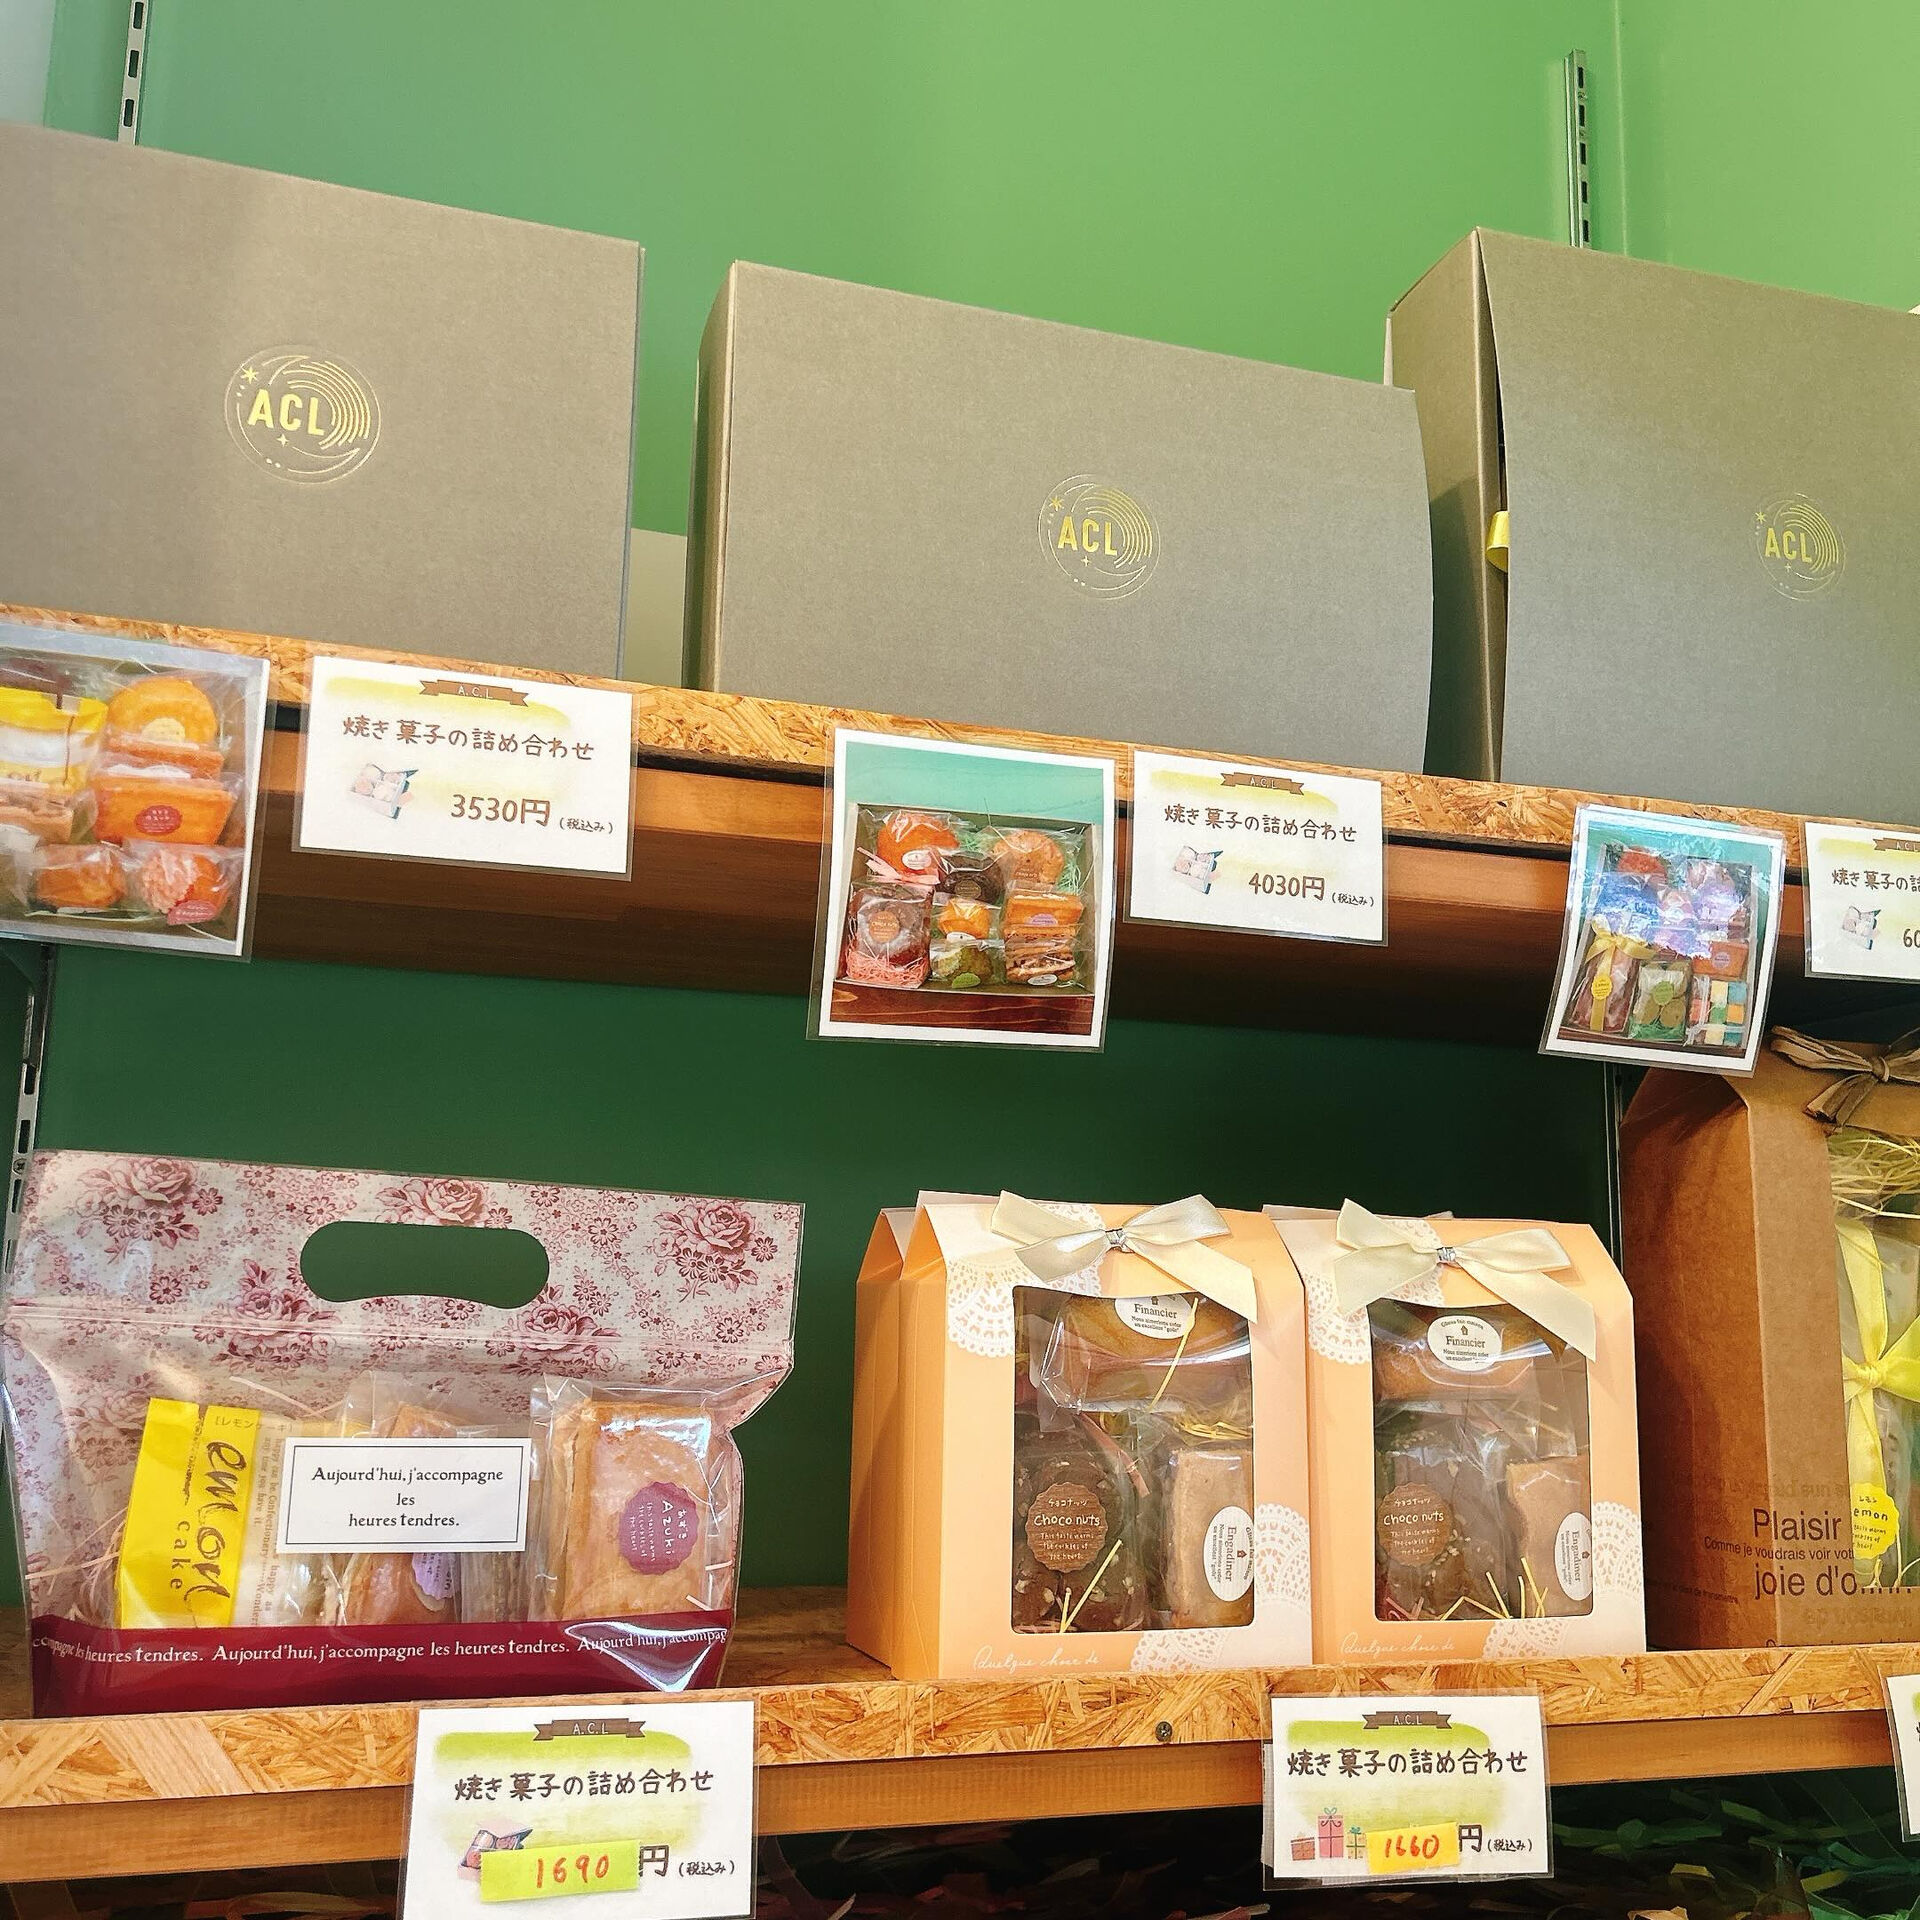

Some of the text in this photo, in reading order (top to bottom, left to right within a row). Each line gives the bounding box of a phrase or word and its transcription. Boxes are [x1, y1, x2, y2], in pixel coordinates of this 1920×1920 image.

[247, 388, 325, 436] ACL
[1058, 515, 1117, 556] ACL
[1765, 527, 1812, 563] ACL
[343, 714, 594, 761] 焼き菓子の詰め合わせ
[451, 794, 614, 835] 3530円 (税込み)
[1164, 803, 1357, 843] 焼き菓子の詰め合わせ
[1249, 872, 1325, 901] 4030円
[1134, 1303, 1178, 1319] Financier
[1445, 1335, 1486, 1348] Financier
[396, 1493, 415, 1506] les
[1422, 1510, 1444, 1522] nuts
[1853, 1508, 1888, 1521] emon
[349, 1513, 460, 1527] heures tendres.
[662, 1500, 674, 1554] Azuki
[1076, 1514, 1100, 1527] nuts
[1753, 1508, 1842, 1541] Plaisir
[170, 1520, 191, 1590] cake
[1225, 1527, 1237, 1582] Engadiner
[1571, 1530, 1581, 1582] Engadiner
[1704, 1536, 1742, 1555] Comme
[1743, 1544, 1753, 1558] je
[1755, 1546, 1806, 1561] voudrais
[1809, 1549, 1832, 1561] voir
[1754, 1563, 1805, 1600] joie
[85, 1645, 132, 1662] heures
[136, 1646, 203, 1663] tendres.
[430, 1641, 450, 1656] les
[455, 1640, 505, 1655] heures
[509, 1639, 570, 1654] tendres.
[1287, 1747, 1528, 1778] 焼き菓子の詰め合わせ
[454, 1767, 714, 1801] 焼き菓子の詰め合わせ
[678, 1860, 736, 1878] (税込み)
